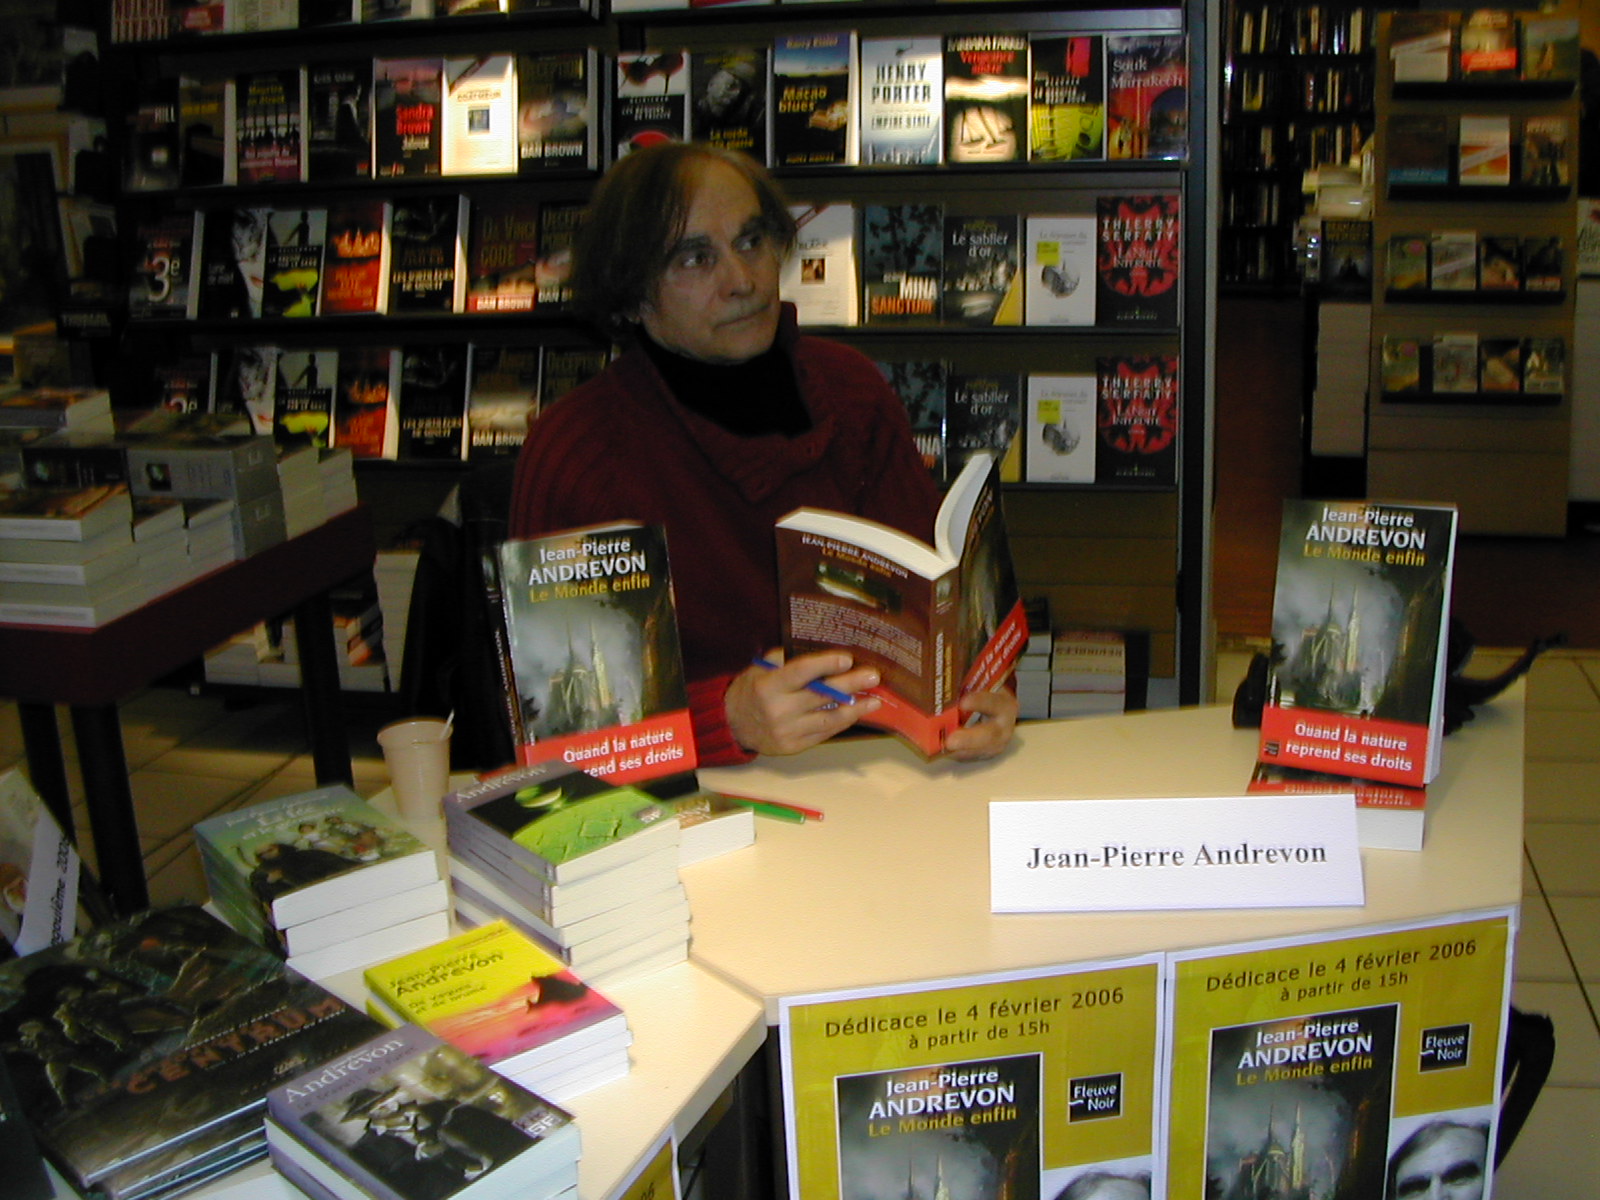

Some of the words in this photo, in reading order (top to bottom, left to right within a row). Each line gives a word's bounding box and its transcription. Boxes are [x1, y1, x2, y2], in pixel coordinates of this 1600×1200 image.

[876, 64, 926, 83] HENRY
[1112, 55, 1148, 72] Souk
[1112, 72, 1183, 89] Marrakech
[783, 85, 828, 100] Macao
[872, 86, 931, 104] PORTER
[154, 104, 175, 123] HILL
[396, 103, 435, 120] Sandra
[779, 99, 816, 113] blues
[396, 119, 432, 136] Brown
[872, 116, 903, 130] EMPIRE
[906, 115, 930, 128] STATE
[521, 143, 542, 159] DAN
[544, 142, 583, 157] BROWN
[1103, 218, 1174, 230] THIERRY
[952, 232, 966, 246] Le
[969, 231, 1009, 247] sablier
[1103, 230, 1174, 241] SERFATY
[969, 246, 992, 258] d'or
[900, 276, 937, 299] MINA
[476, 294, 497, 311] DAN
[497, 293, 532, 310] BROWN
[872, 297, 935, 315] SANCTUM
[1102, 375, 1173, 388] THIERRY
[955, 389, 968, 404] Le
[971, 389, 1010, 405] sablier
[1102, 388, 1173, 400] SERFATY
[970, 402, 993, 416] d'or
[473, 430, 494, 446] DAN
[495, 430, 526, 446] BROW
[1322, 505, 1414, 528] Jean-Pierre
[1305, 522, 1426, 550] ANDREVON
[539, 539, 632, 564] Jean-Pierre
[801, 534, 860, 558] JEAN-PIERRE
[861, 552, 909, 579] ANDREVON
[1304, 543, 1322, 558] Le
[1328, 546, 1380, 563] Monde
[1386, 550, 1427, 567] enfin
[528, 552, 647, 586] ANDREVON
[530, 587, 549, 604] Le
[554, 579, 609, 599] Monde
[612, 573, 651, 593] enfin
[563, 738, 610, 764] Quand
[612, 735, 627, 753] la
[630, 729, 674, 749] nature
[1294, 722, 1341, 742] Quand
[1344, 727, 1357, 744] la
[1361, 733, 1408, 751] nature
[583, 759, 616, 778] rend
[619, 754, 643, 772] ses
[644, 744, 685, 767] droits
[1285, 741, 1341, 761] reprend
[1344, 751, 1367, 765] ses
[1370, 754, 1413, 772] droits
[1027, 845, 1184, 869] Jean-Pierre
[1193, 842, 1328, 866] Andrevon
[397, 952, 504, 998] Andrevon
[1206, 967, 1300, 992] Dédicace
[1308, 961, 1326, 978] le
[1335, 958, 1347, 974] 4
[1356, 950, 1421, 972] février
[1429, 939, 1477, 961] 2006
[1280, 988, 1290, 1002] à
[1297, 981, 1343, 1002] partir
[1351, 978, 1371, 992] de
[1379, 972, 1409, 988] 15h
[826, 1013, 928, 1038] Dédicace
[938, 1008, 957, 1026] le
[966, 1004, 979, 1021] 4
[989, 996, 1061, 1019] février
[1071, 987, 1125, 1010] 2006
[908, 1034, 919, 1050] à
[928, 1027, 979, 1050] partir
[987, 1025, 1009, 1042] de
[1018, 1019, 1050, 1038] 15h
[1256, 1019, 1360, 1048] Jean-Pierre
[1425, 1033, 1465, 1048] Fleuve
[127, 998, 343, 1093] CENTRUM
[1238, 1035, 1373, 1070] ANDREVON
[1437, 1046, 1463, 1062] Noir
[284, 1039, 404, 1103] Andrevon
[1236, 1070, 1258, 1086] Le
[1265, 1062, 1325, 1082] Monde
[1330, 1056, 1373, 1074] enfin
[886, 1070, 999, 1097] Jean-Pierre
[1073, 1082, 1118, 1099] Fleuve
[868, 1083, 1015, 1120] ANDREVON
[1087, 1096, 1117, 1112] Noir
[868, 1120, 892, 1137] Le
[899, 1113, 964, 1134] Monde
[970, 1106, 1018, 1126] enfin
